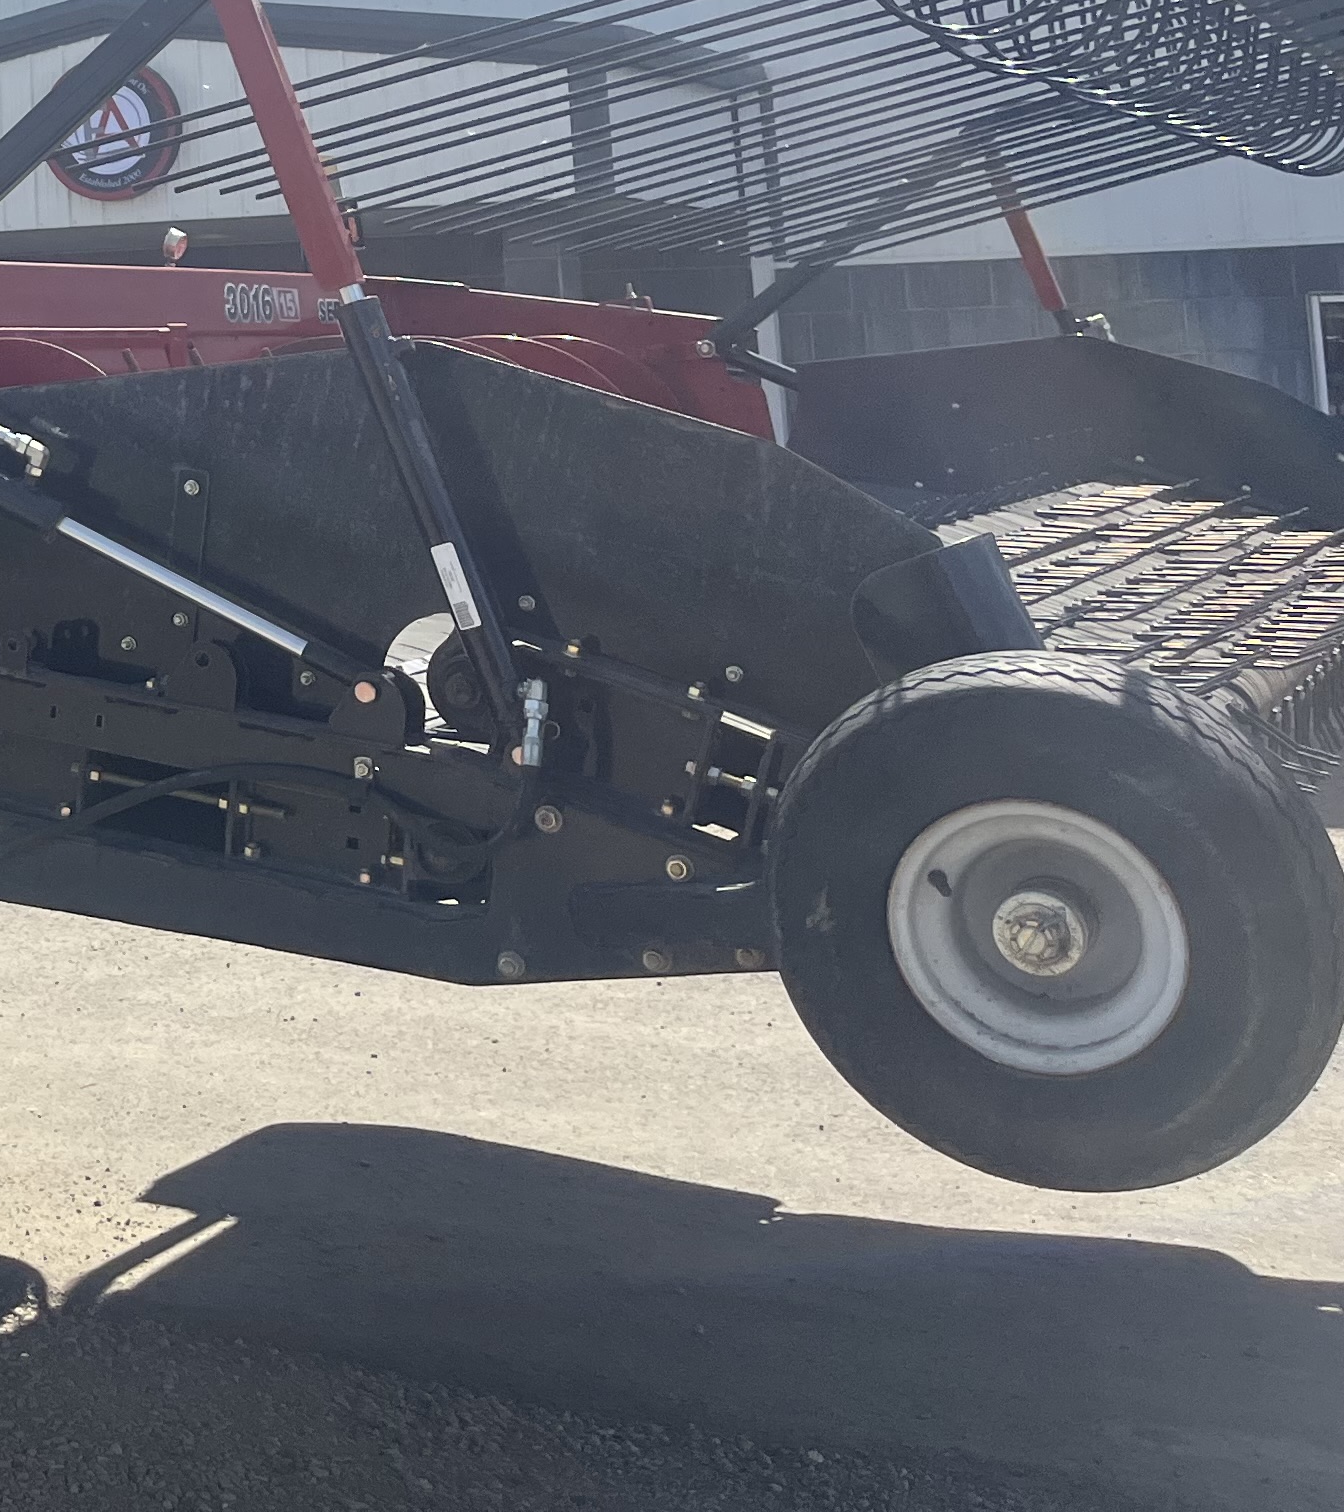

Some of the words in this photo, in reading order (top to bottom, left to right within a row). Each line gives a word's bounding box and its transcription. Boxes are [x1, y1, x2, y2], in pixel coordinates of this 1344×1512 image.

[78, 172, 122, 188] Established
[224, 282, 275, 324] 3016
[278, 290, 298, 319] 15
